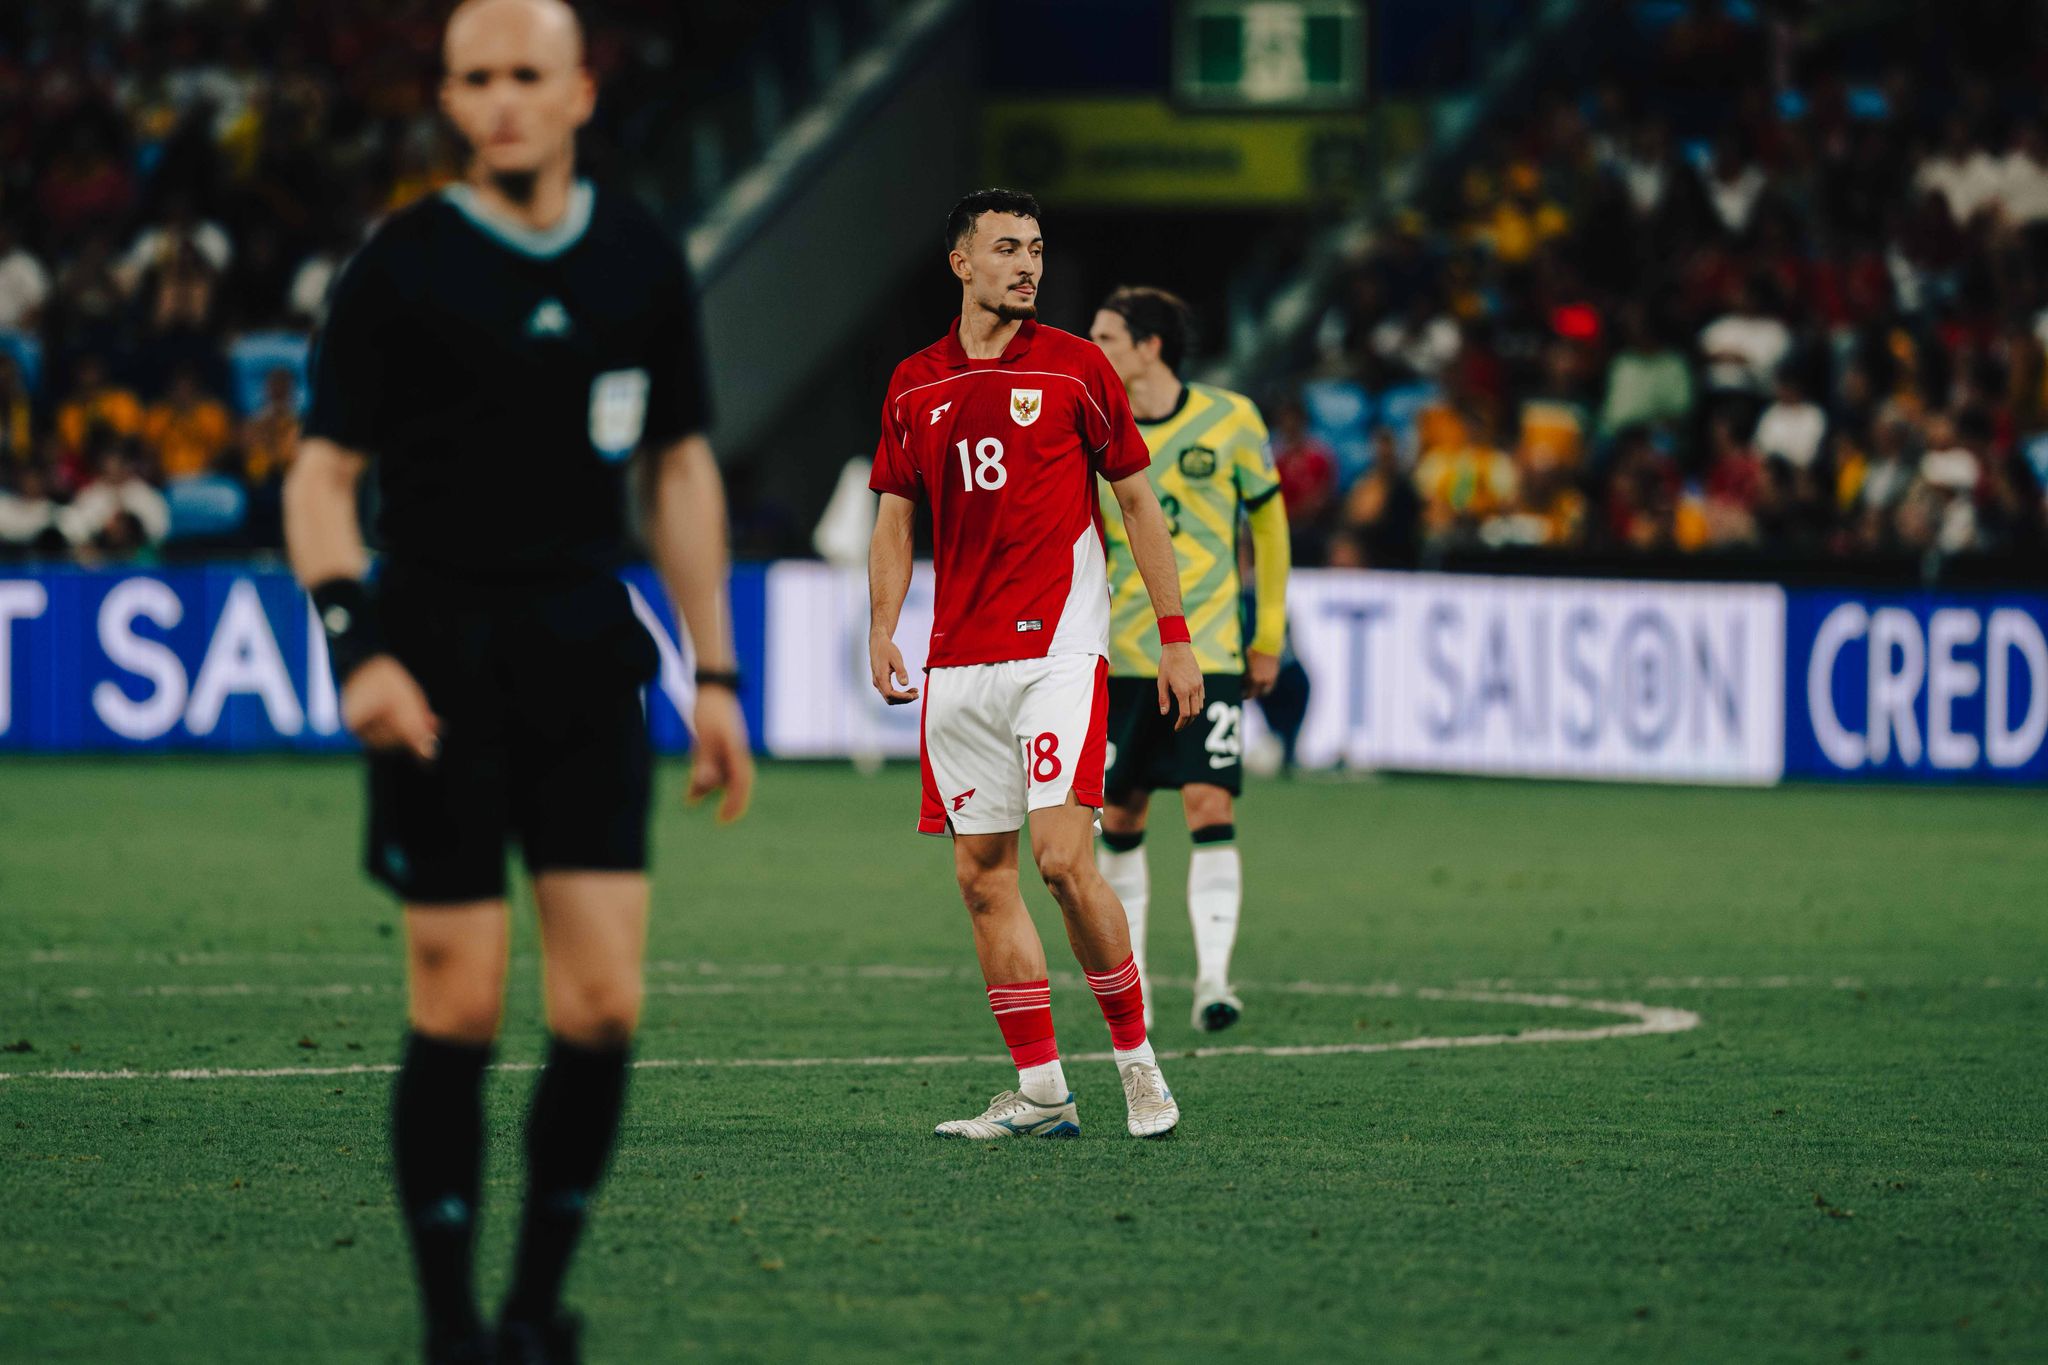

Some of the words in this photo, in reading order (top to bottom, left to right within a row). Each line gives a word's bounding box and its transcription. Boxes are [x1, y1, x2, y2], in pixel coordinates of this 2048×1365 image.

[956, 437, 1007, 492] 18
[1419, 603, 1751, 750] SAISON
[1808, 602, 2048, 768] CRED
[1205, 701, 1242, 755] 23
[1026, 731, 1062, 789] 18
